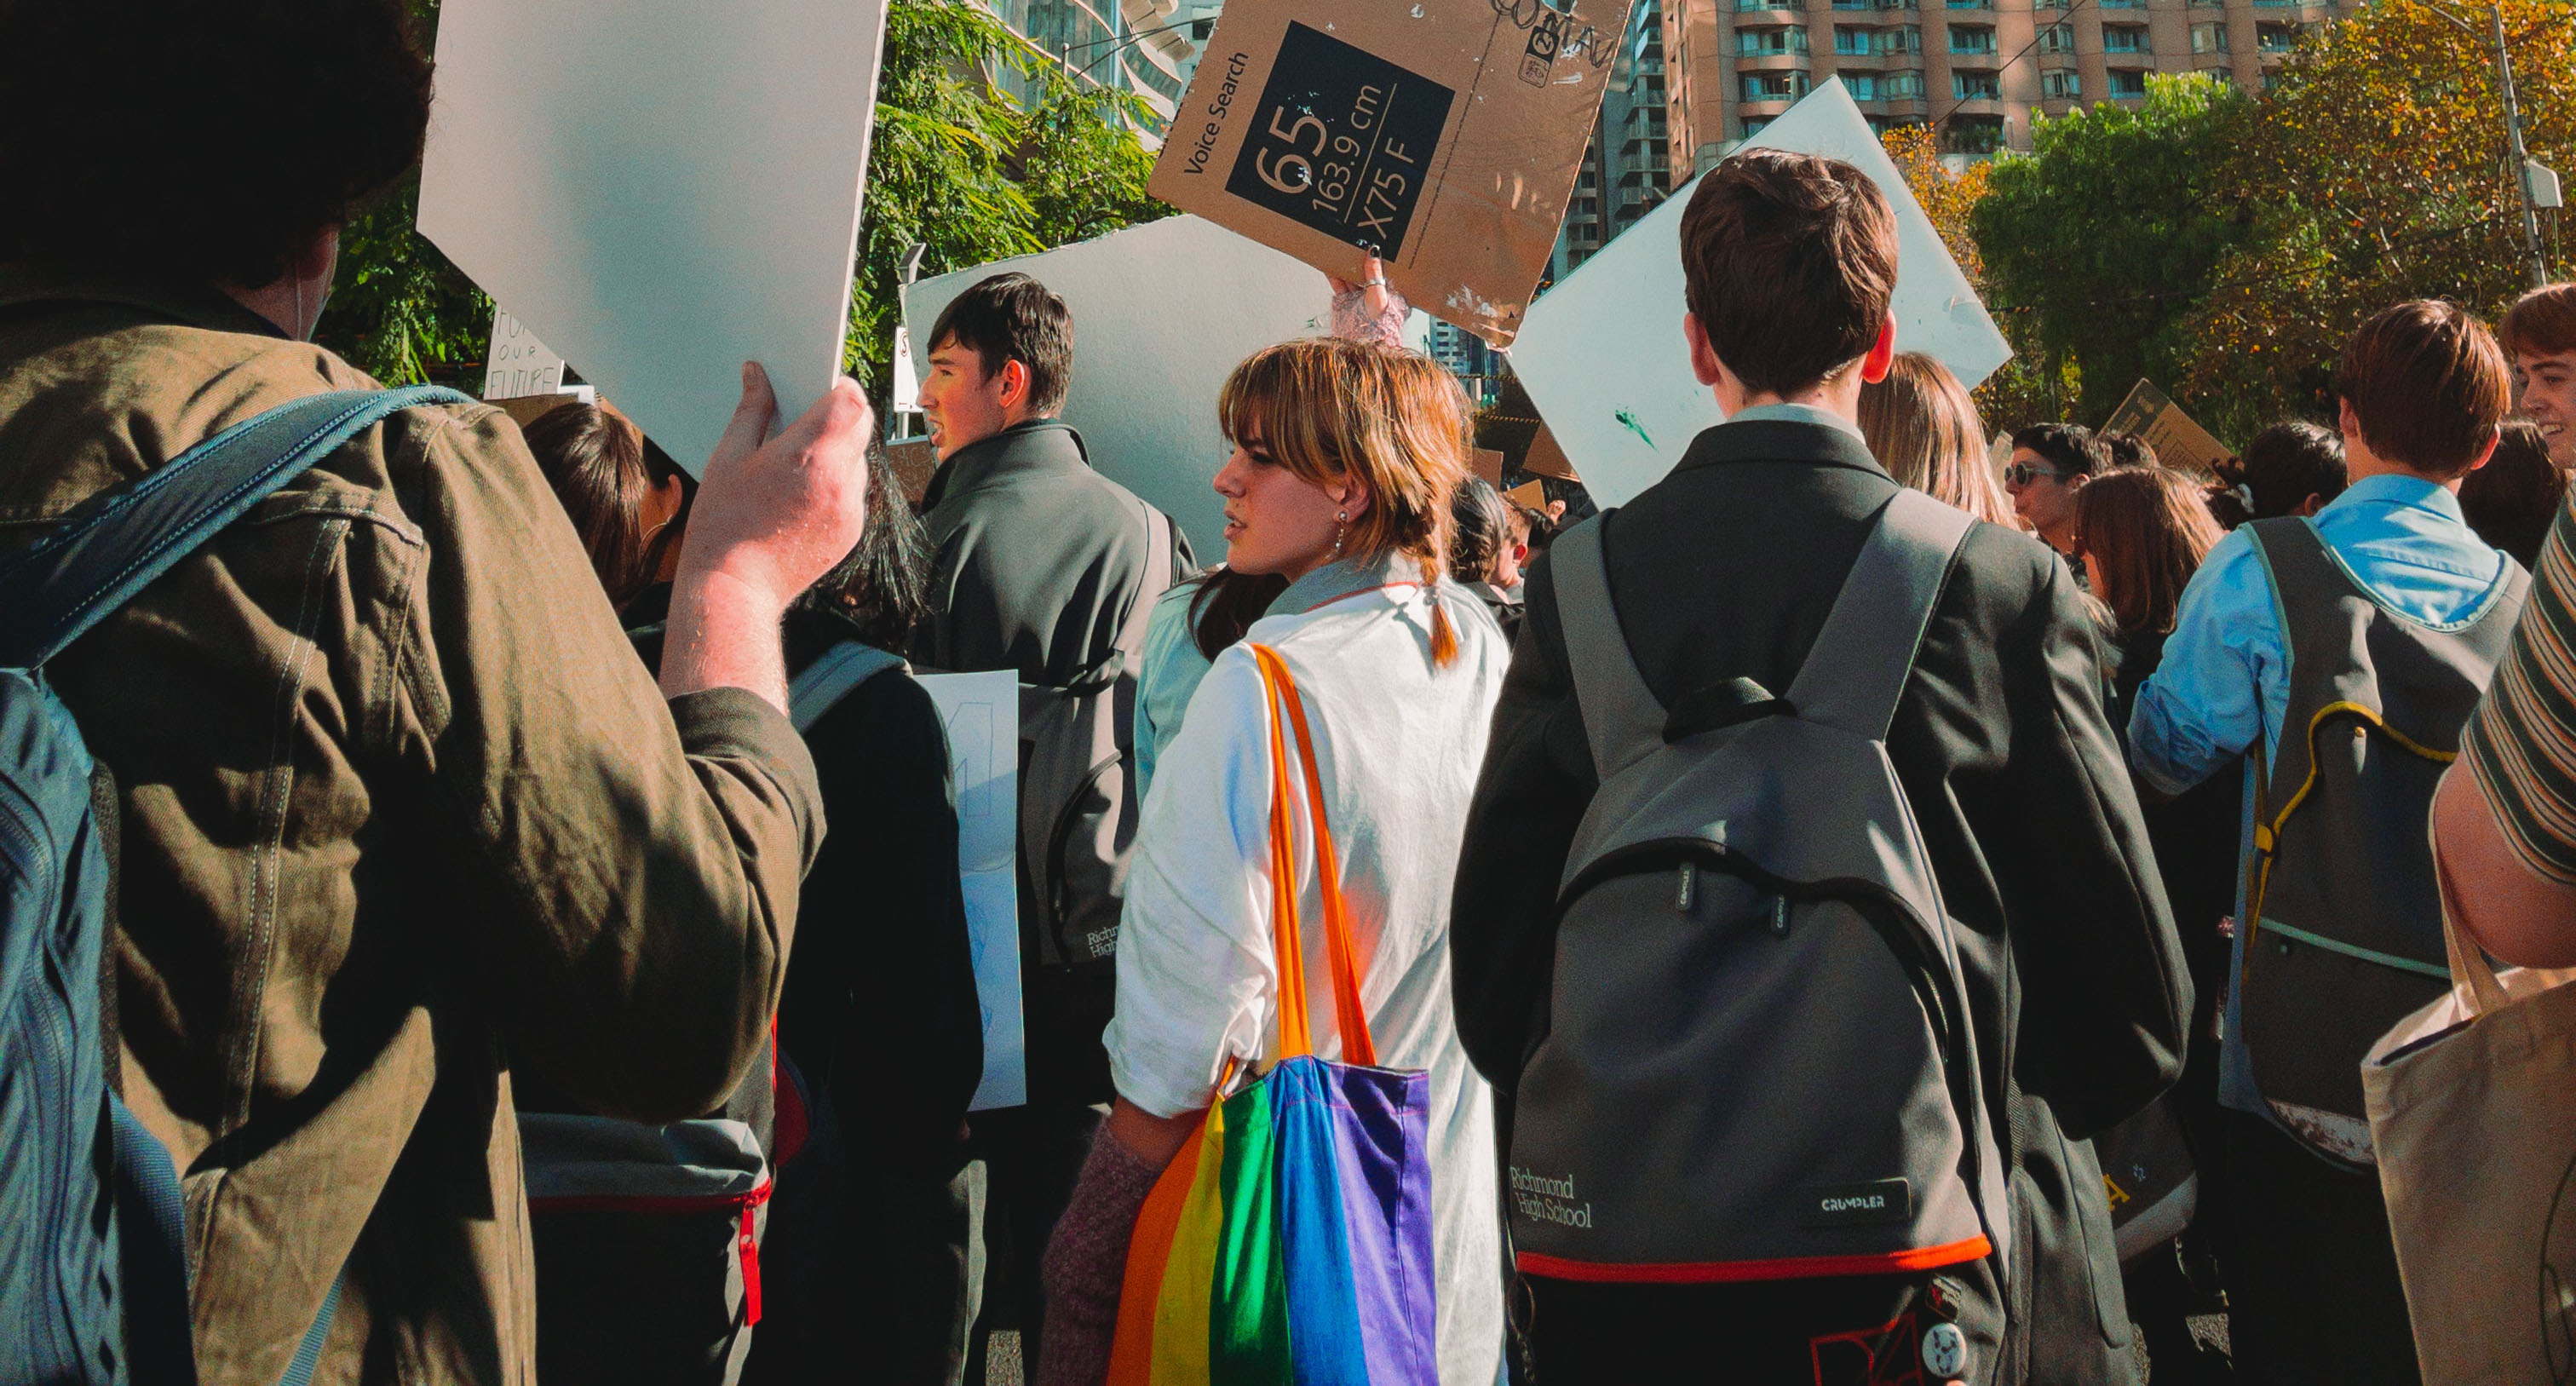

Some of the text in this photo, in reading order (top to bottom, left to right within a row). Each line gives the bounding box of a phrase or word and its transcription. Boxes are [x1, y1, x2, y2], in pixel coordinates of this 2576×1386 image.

[1184, 51, 1249, 175] Voice Search
[1256, 105, 1328, 194] 65
[1312, 84, 1382, 213] 163.9 cm
[1357, 137, 1415, 239] X75 F
[498, 344, 537, 361] OUR
[490, 366, 555, 400] FUTURE
[1509, 1166, 1574, 1199] Richmond
[1515, 1192, 1593, 1228] High School
[1821, 1194, 1885, 1211] CRUMPLER
